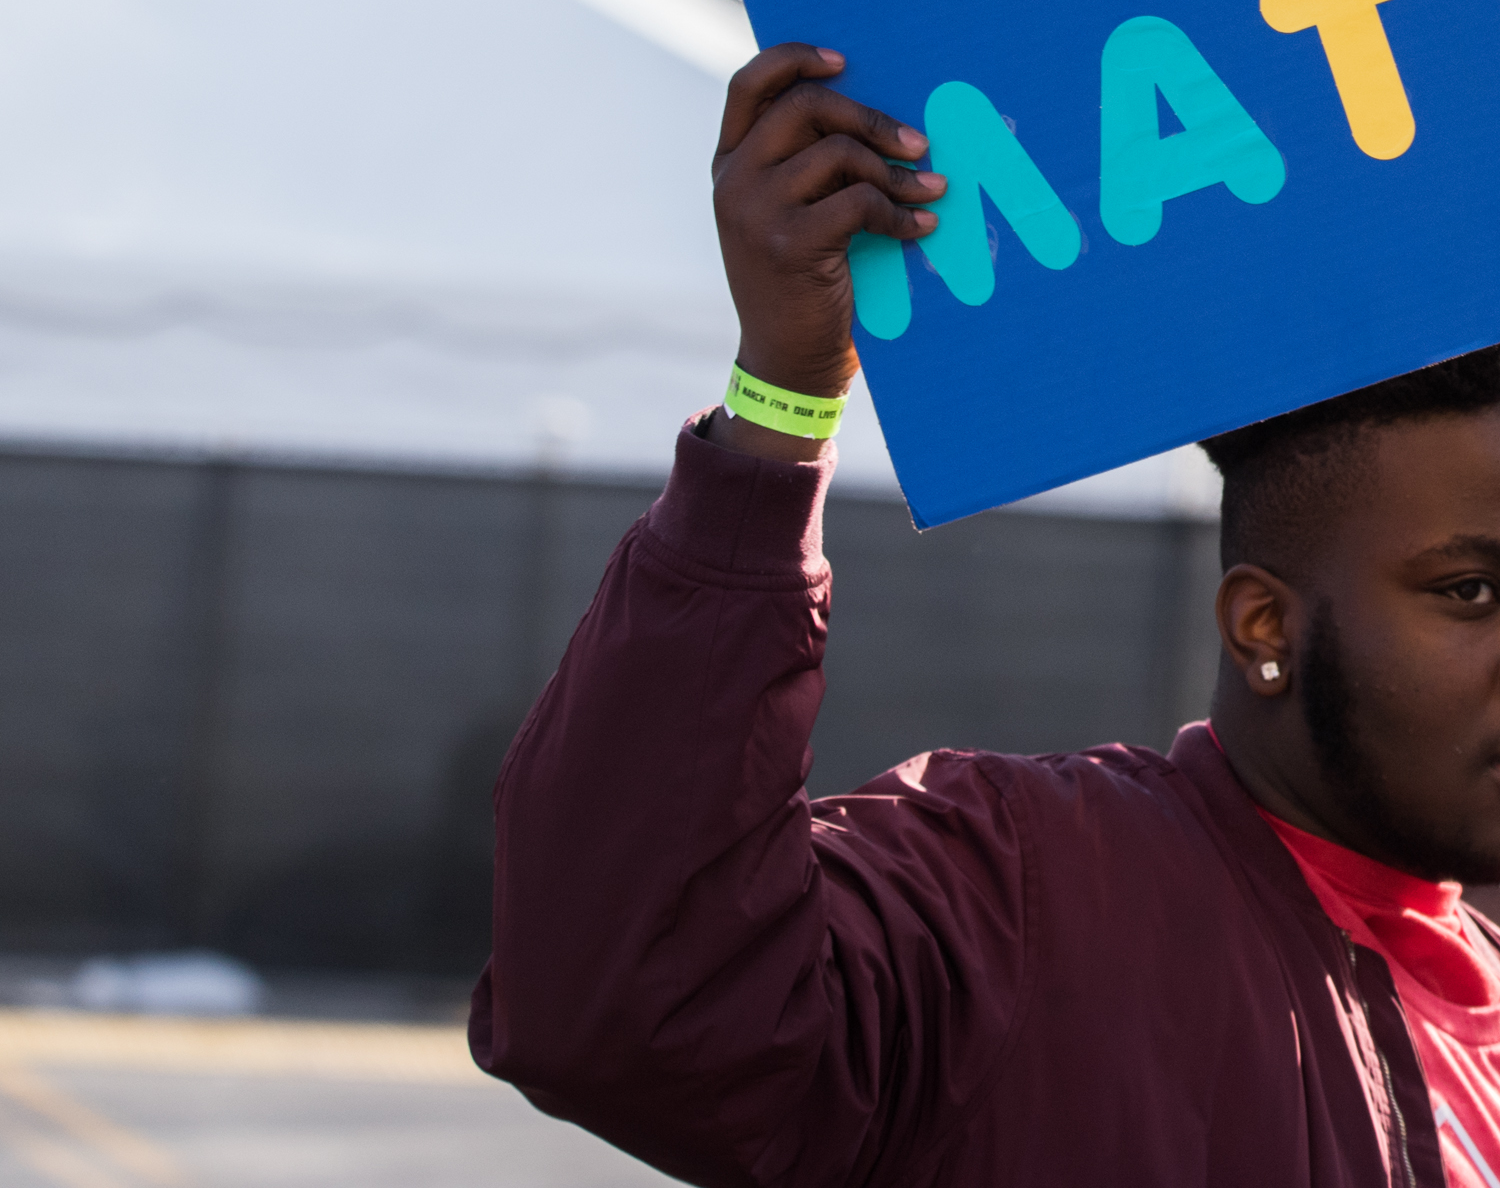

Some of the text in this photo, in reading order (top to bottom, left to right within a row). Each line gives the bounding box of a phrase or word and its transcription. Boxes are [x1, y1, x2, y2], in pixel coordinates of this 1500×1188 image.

[742, 386, 767, 405] MARCH
[768, 398, 789, 412] FOR
[793, 405, 816, 419] OUR
[818, 408, 838, 420] LIVES
